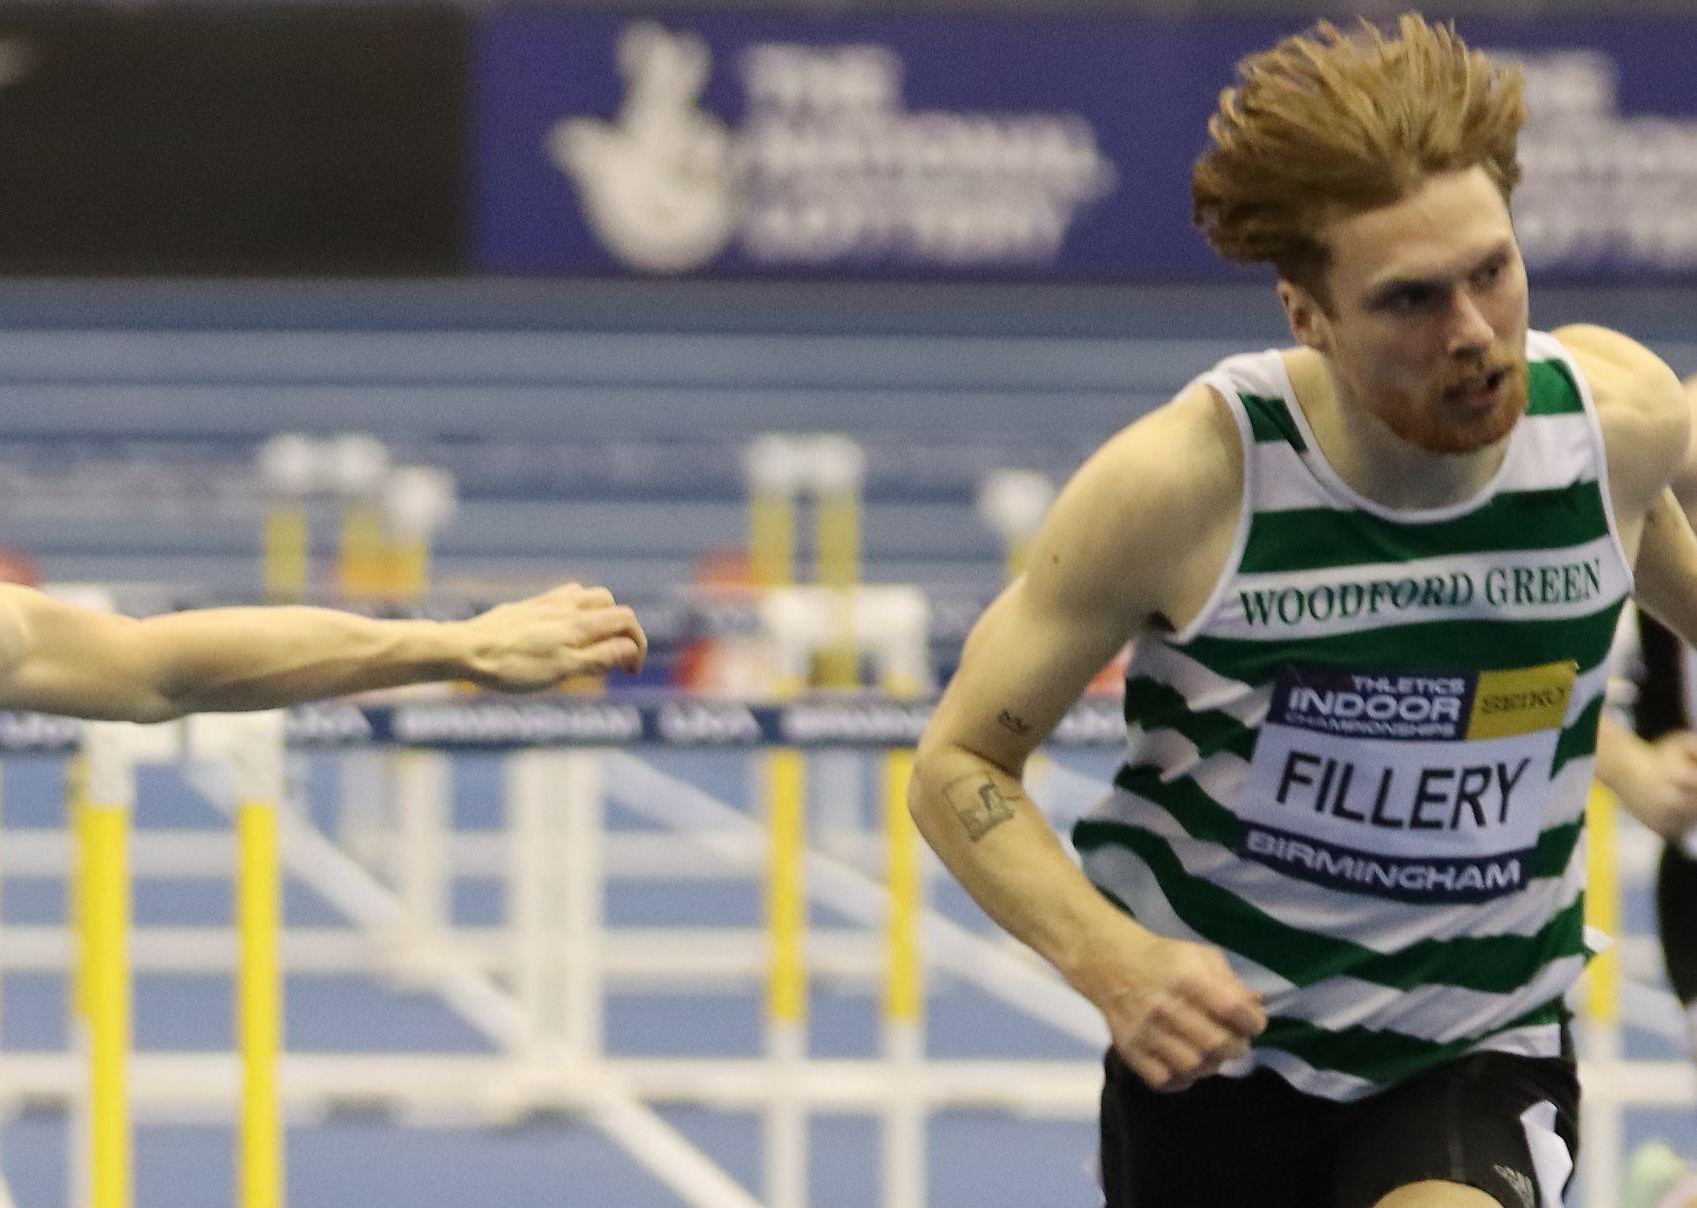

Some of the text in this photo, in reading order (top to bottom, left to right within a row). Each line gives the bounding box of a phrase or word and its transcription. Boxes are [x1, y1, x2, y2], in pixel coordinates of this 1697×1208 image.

[1240, 558, 1603, 627] WOODFORD GREEN
[1288, 686, 1462, 722] INDOOR
[1276, 750, 1530, 831] FILLERY
[1245, 830, 1522, 890] BIRMINGHAM
